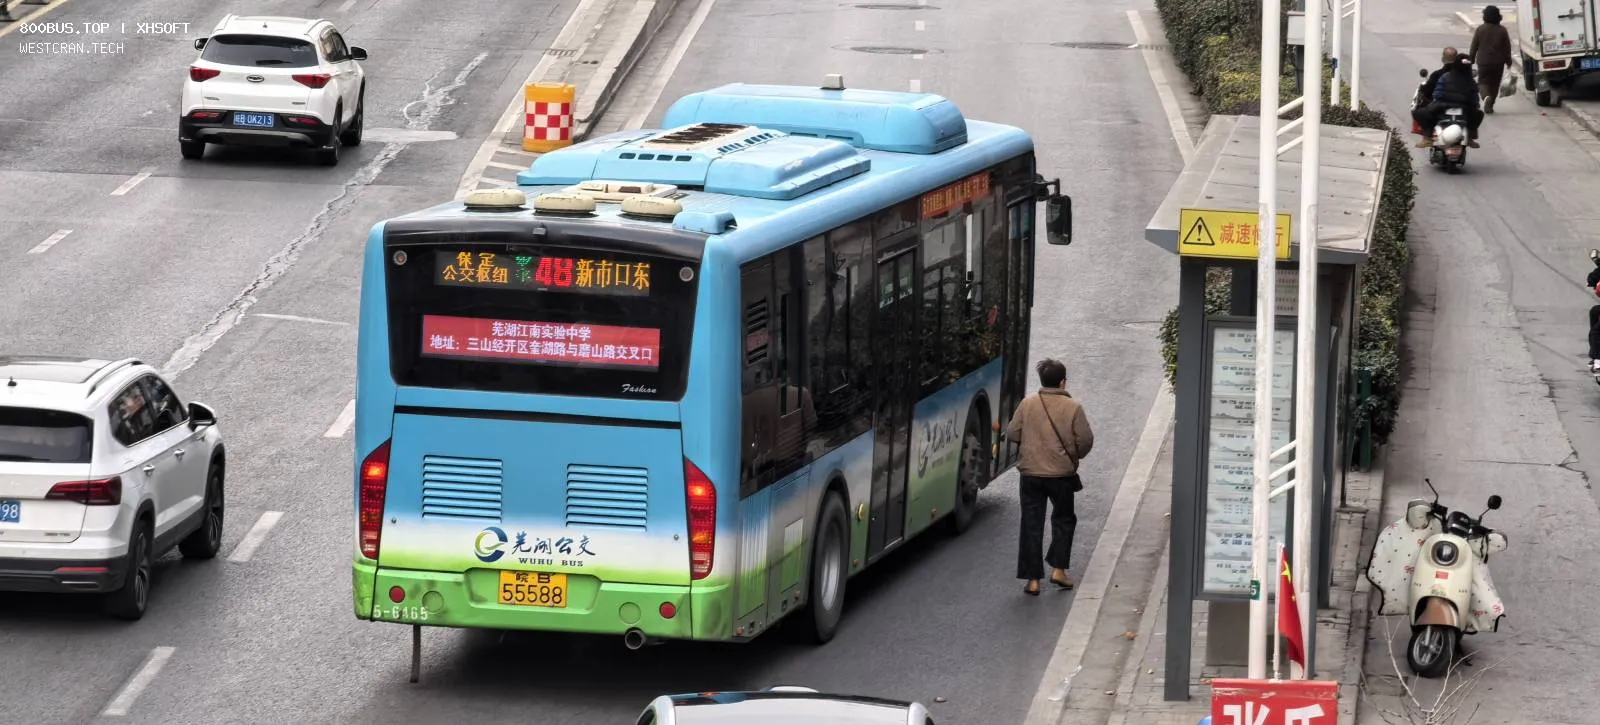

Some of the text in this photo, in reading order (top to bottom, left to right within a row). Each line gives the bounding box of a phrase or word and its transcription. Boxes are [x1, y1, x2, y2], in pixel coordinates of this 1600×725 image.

[1220, 222, 1284, 248] 减速行
[442, 265, 508, 283] 公交枢纽
[535, 257, 573, 287] 48
[576, 258, 650, 289] 新市口东
[492, 321, 591, 341] 芜湖江南实验中学
[621, 383, 657, 393] Fashion
[0, 503, 18, 518] 98
[512, 530, 596, 556] 芜湖公交
[518, 557, 584, 567] WUHU BUS
[502, 583, 563, 605] 55588
[372, 604, 428, 621] 5-6465
